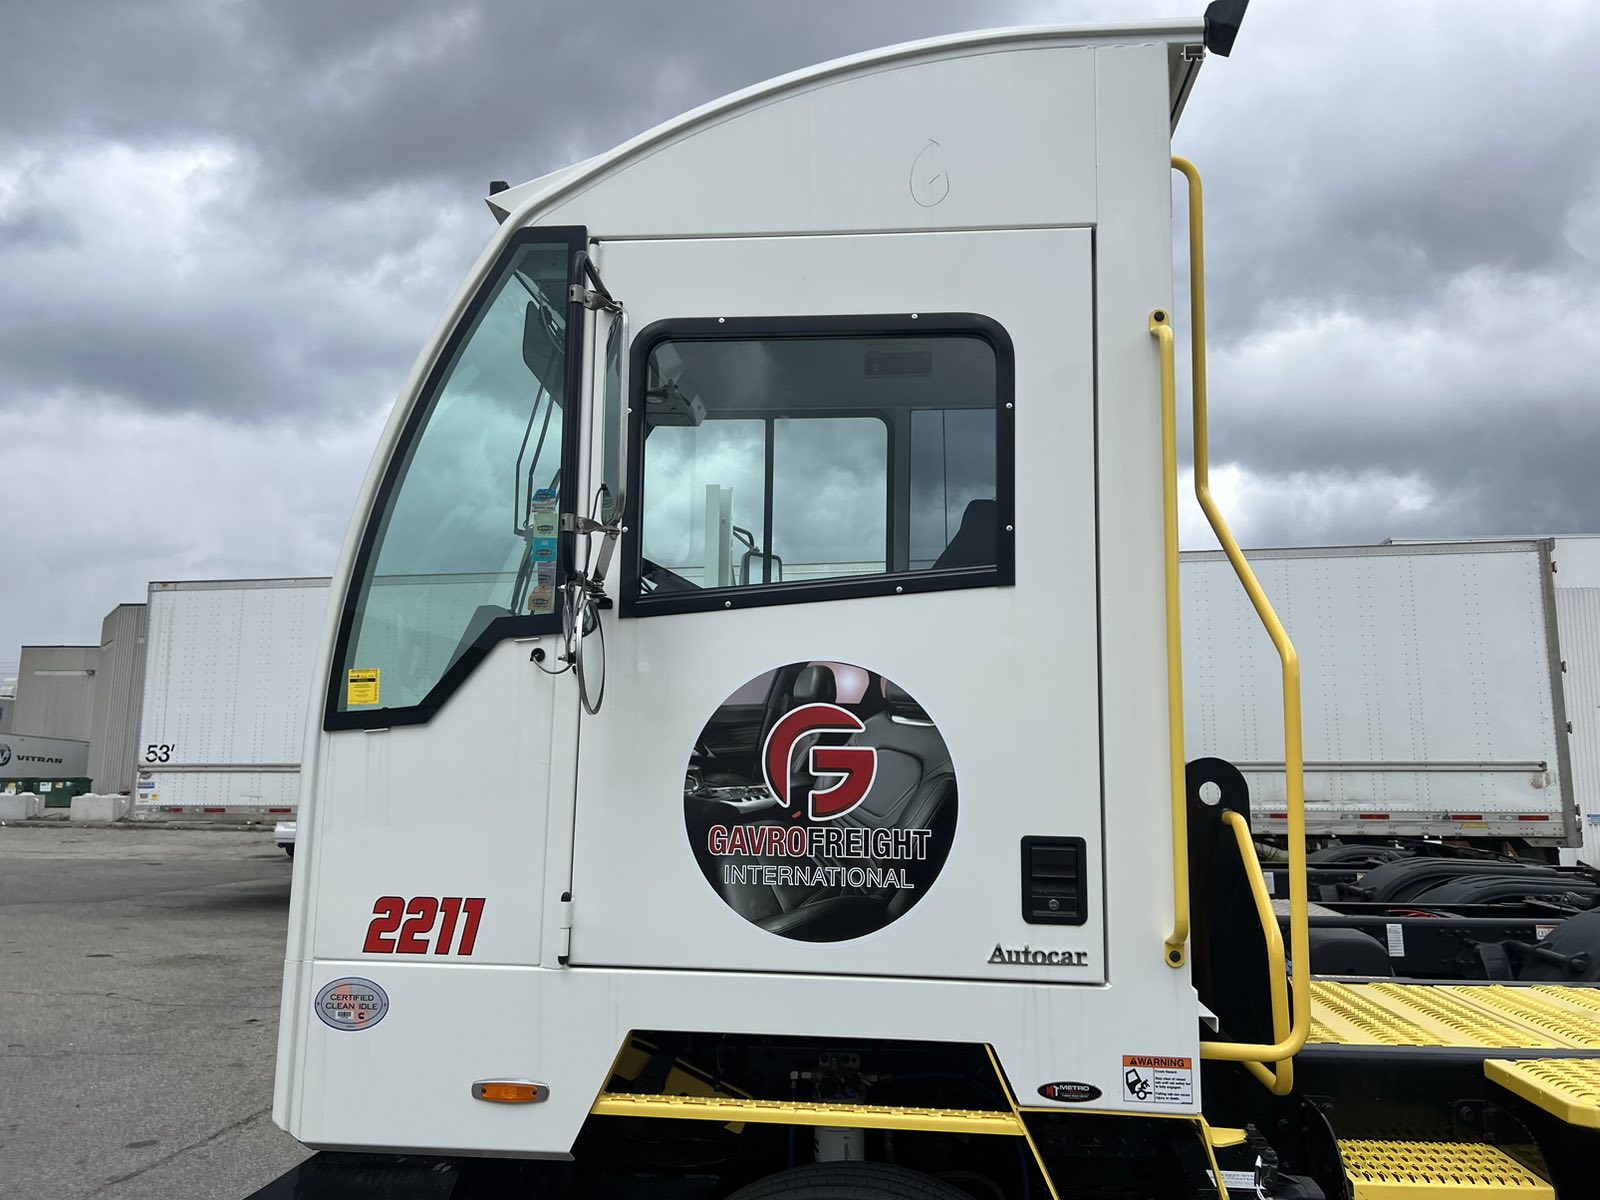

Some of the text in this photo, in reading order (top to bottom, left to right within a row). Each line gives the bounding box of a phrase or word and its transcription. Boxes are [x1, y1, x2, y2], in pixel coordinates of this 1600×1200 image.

[16, 754, 63, 764] VITRAN
[145, 744, 175, 763] 53'
[724, 864, 915, 889] INTERNATIONAL
[362, 896, 486, 956] 2211
[987, 942, 1089, 967] Autocar
[330, 993, 374, 1002] CERTIFIED
[325, 1002, 378, 1011] CLEAN IDLE
[1137, 1057, 1184, 1067] WARNING
